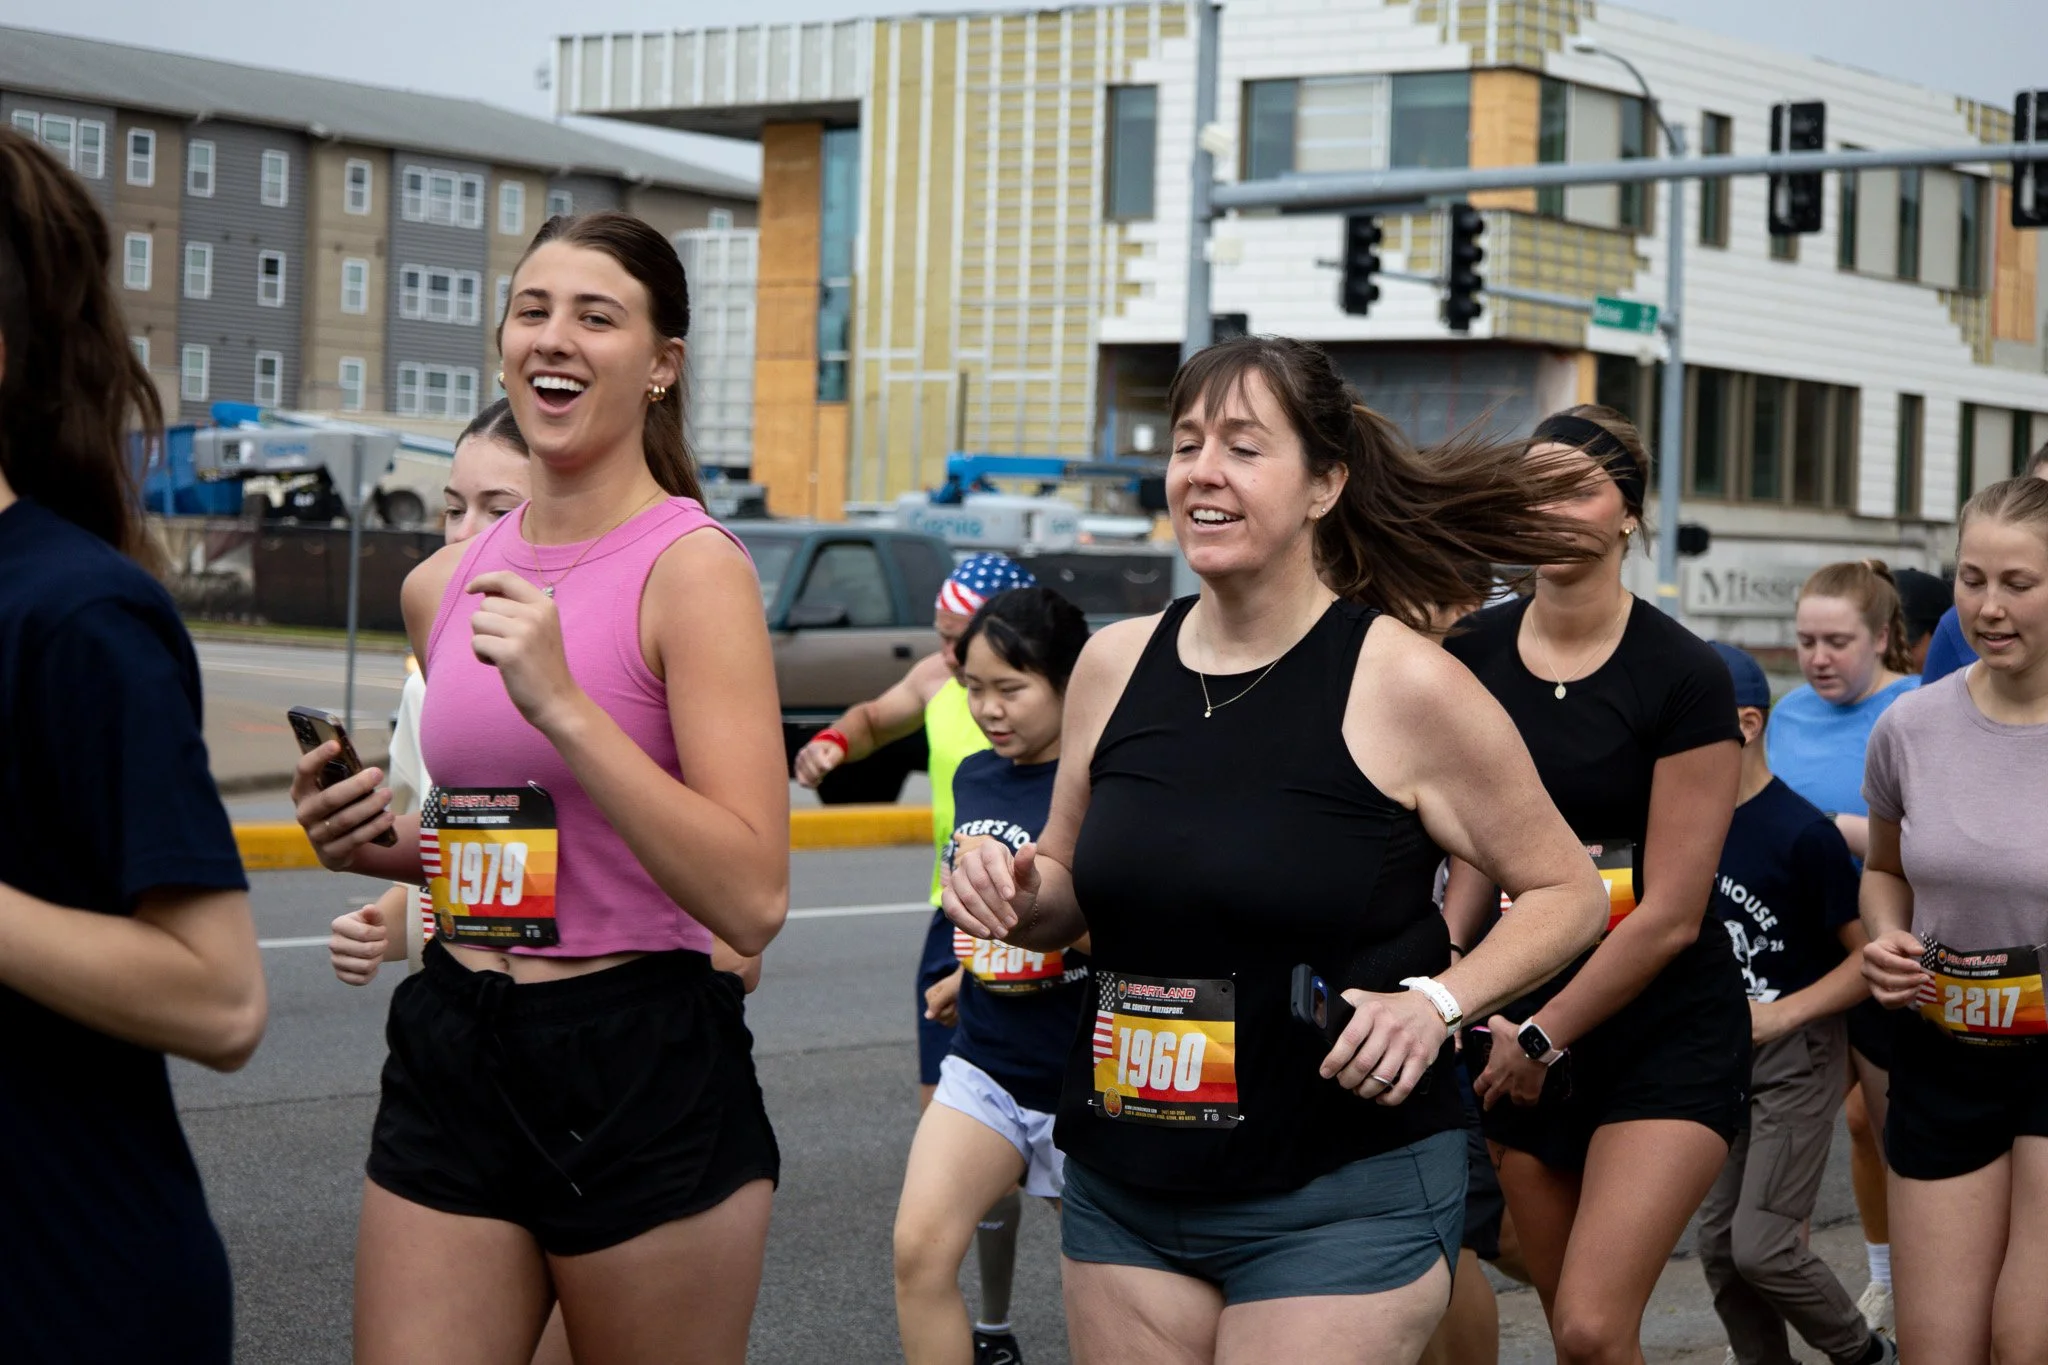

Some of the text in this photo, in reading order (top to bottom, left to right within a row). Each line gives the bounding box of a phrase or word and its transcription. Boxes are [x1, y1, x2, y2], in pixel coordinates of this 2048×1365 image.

[956, 819, 1032, 850] TER'S HO
[449, 841, 528, 906] 1979
[1720, 875, 1779, 932] HOUSE
[1128, 983, 1196, 999] HEARTLAND
[1944, 985, 2020, 1028] 2217
[1117, 1027, 1207, 1092] 1960
